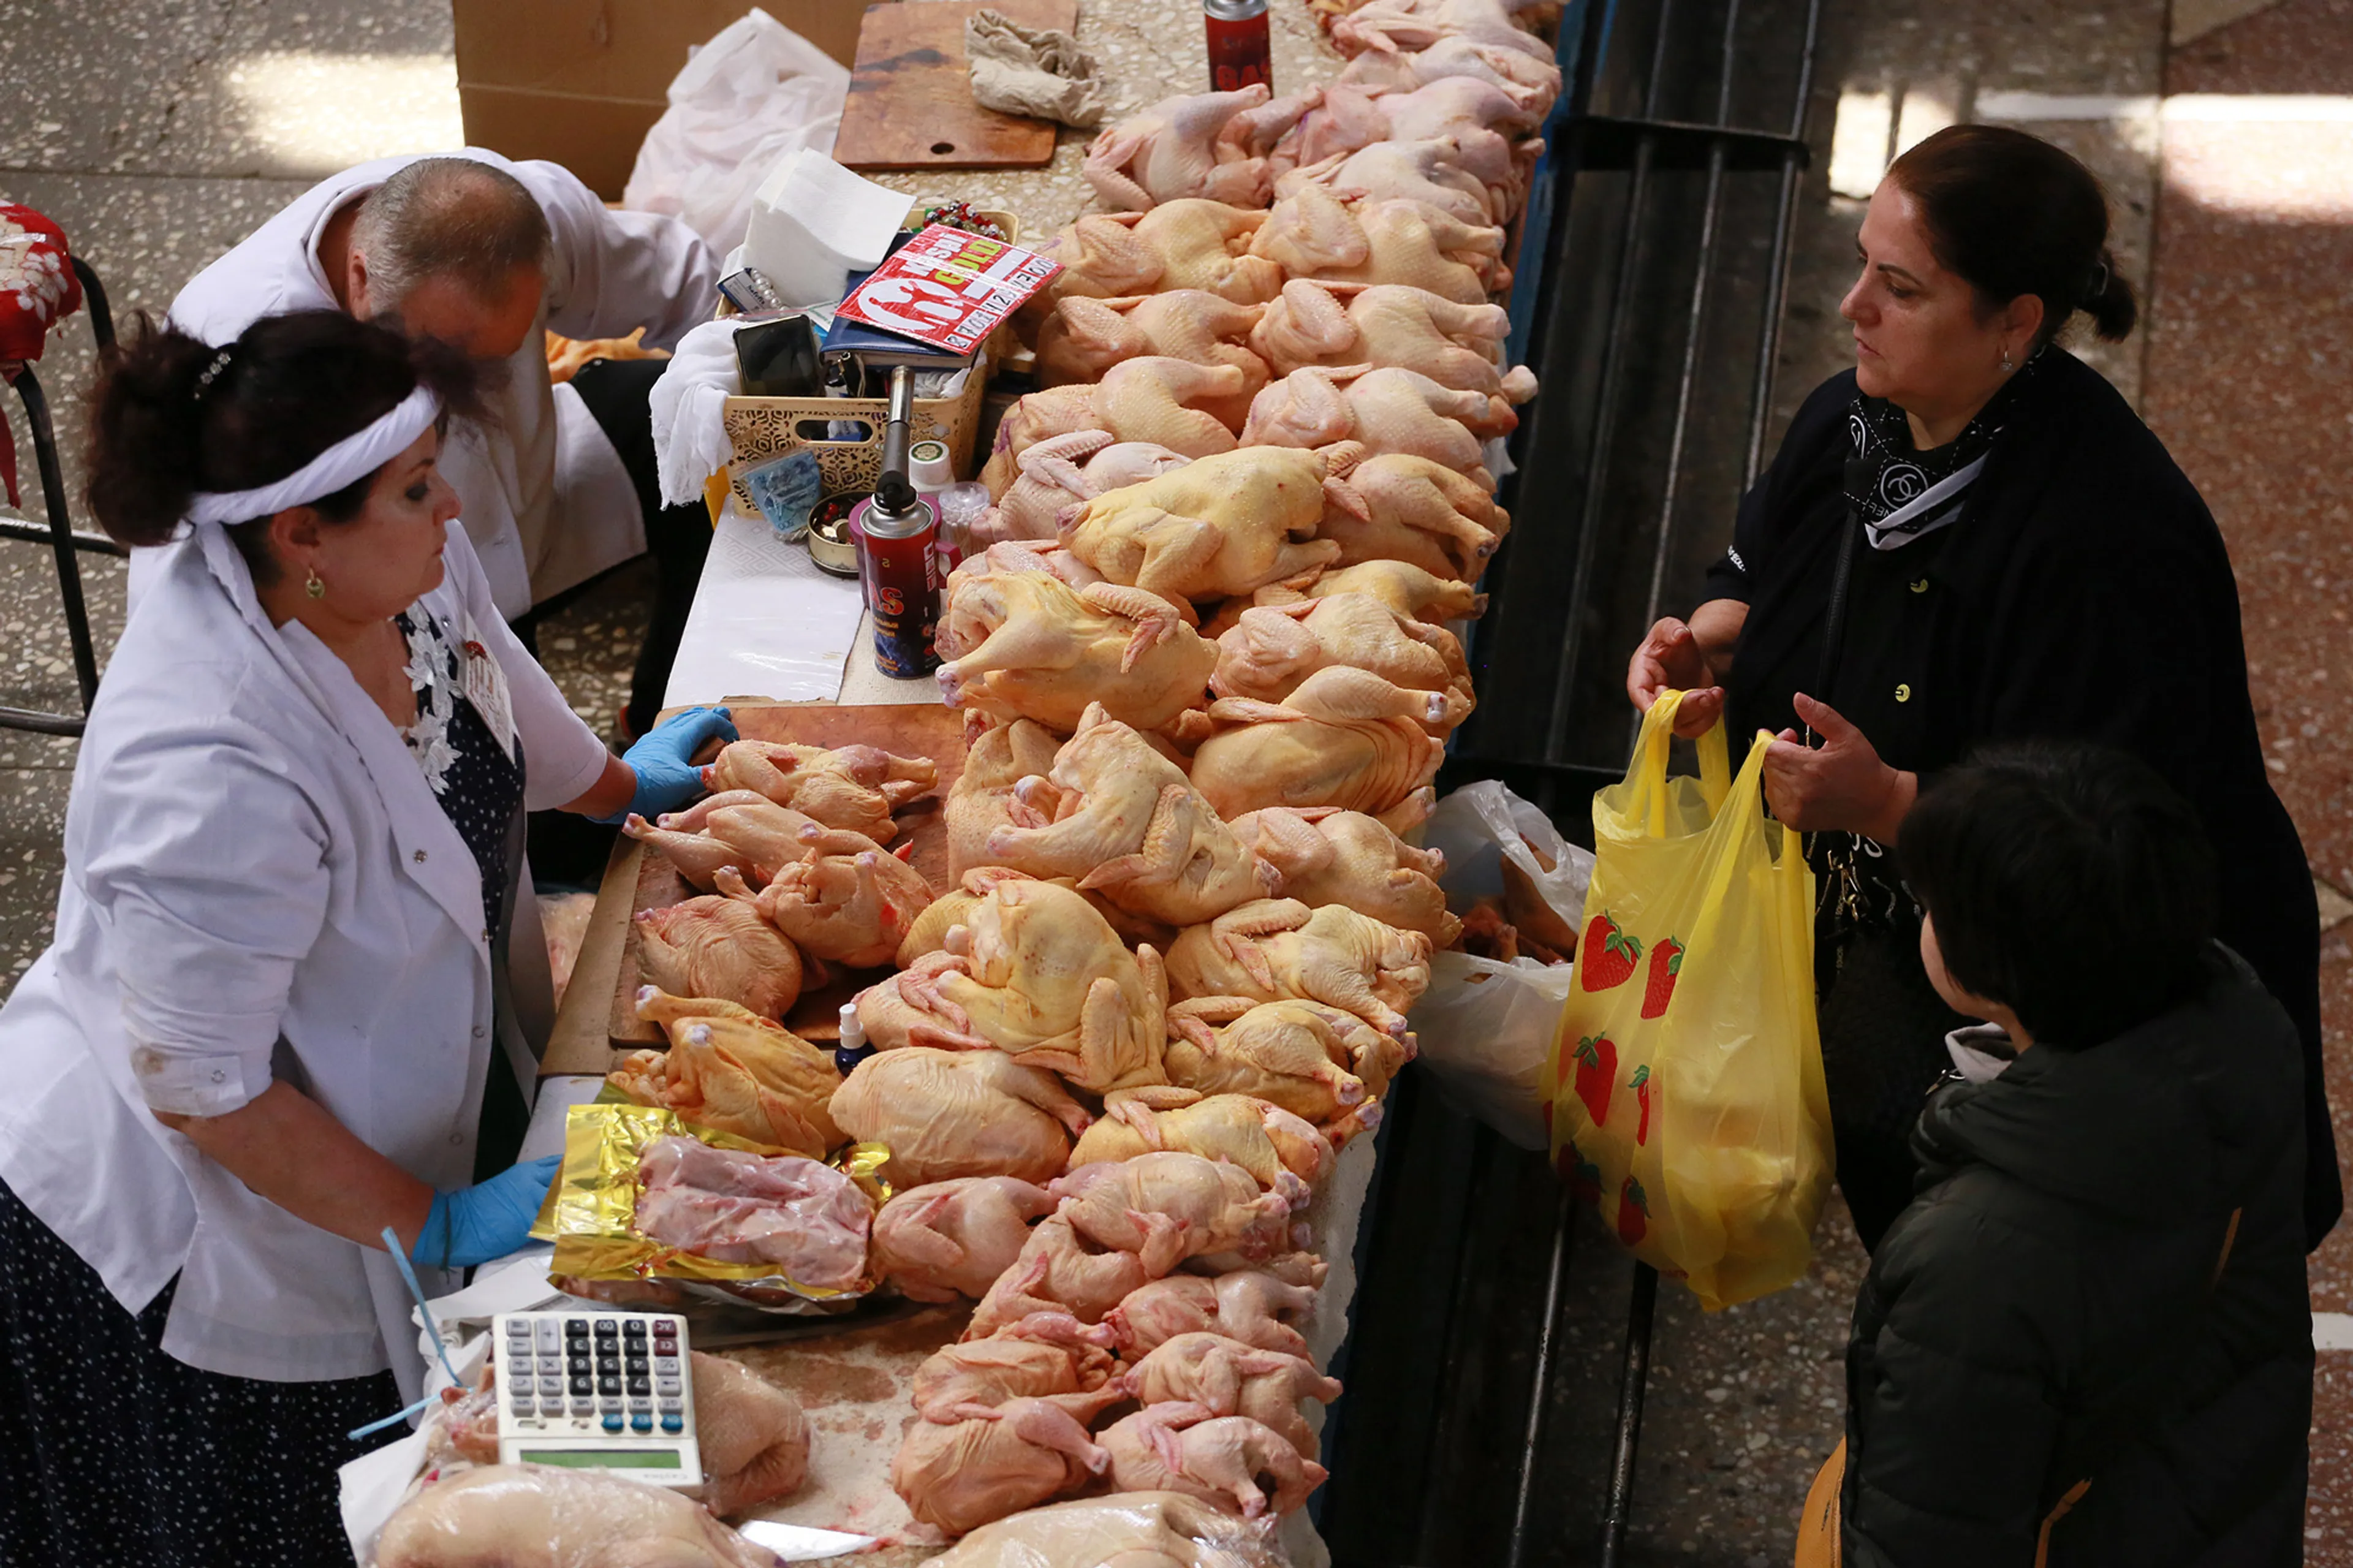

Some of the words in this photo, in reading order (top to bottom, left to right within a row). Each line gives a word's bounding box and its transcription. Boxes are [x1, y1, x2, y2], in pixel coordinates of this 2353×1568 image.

[934, 240, 1003, 286] GOLD
[947, 336, 968, 348] 8
[598, 1321, 614, 1330] 00
[630, 1321, 640, 1330] 0
[657, 1322, 672, 1330] AC
[574, 1339, 585, 1350] 3
[602, 1339, 612, 1349] 2
[632, 1341, 638, 1349] 1
[575, 1359, 586, 1369] 6
[604, 1359, 613, 1369] 5
[632, 1360, 643, 1369] 4
[577, 1377, 586, 1388] 9
[604, 1377, 615, 1388] 8
[634, 1379, 644, 1388] 7
